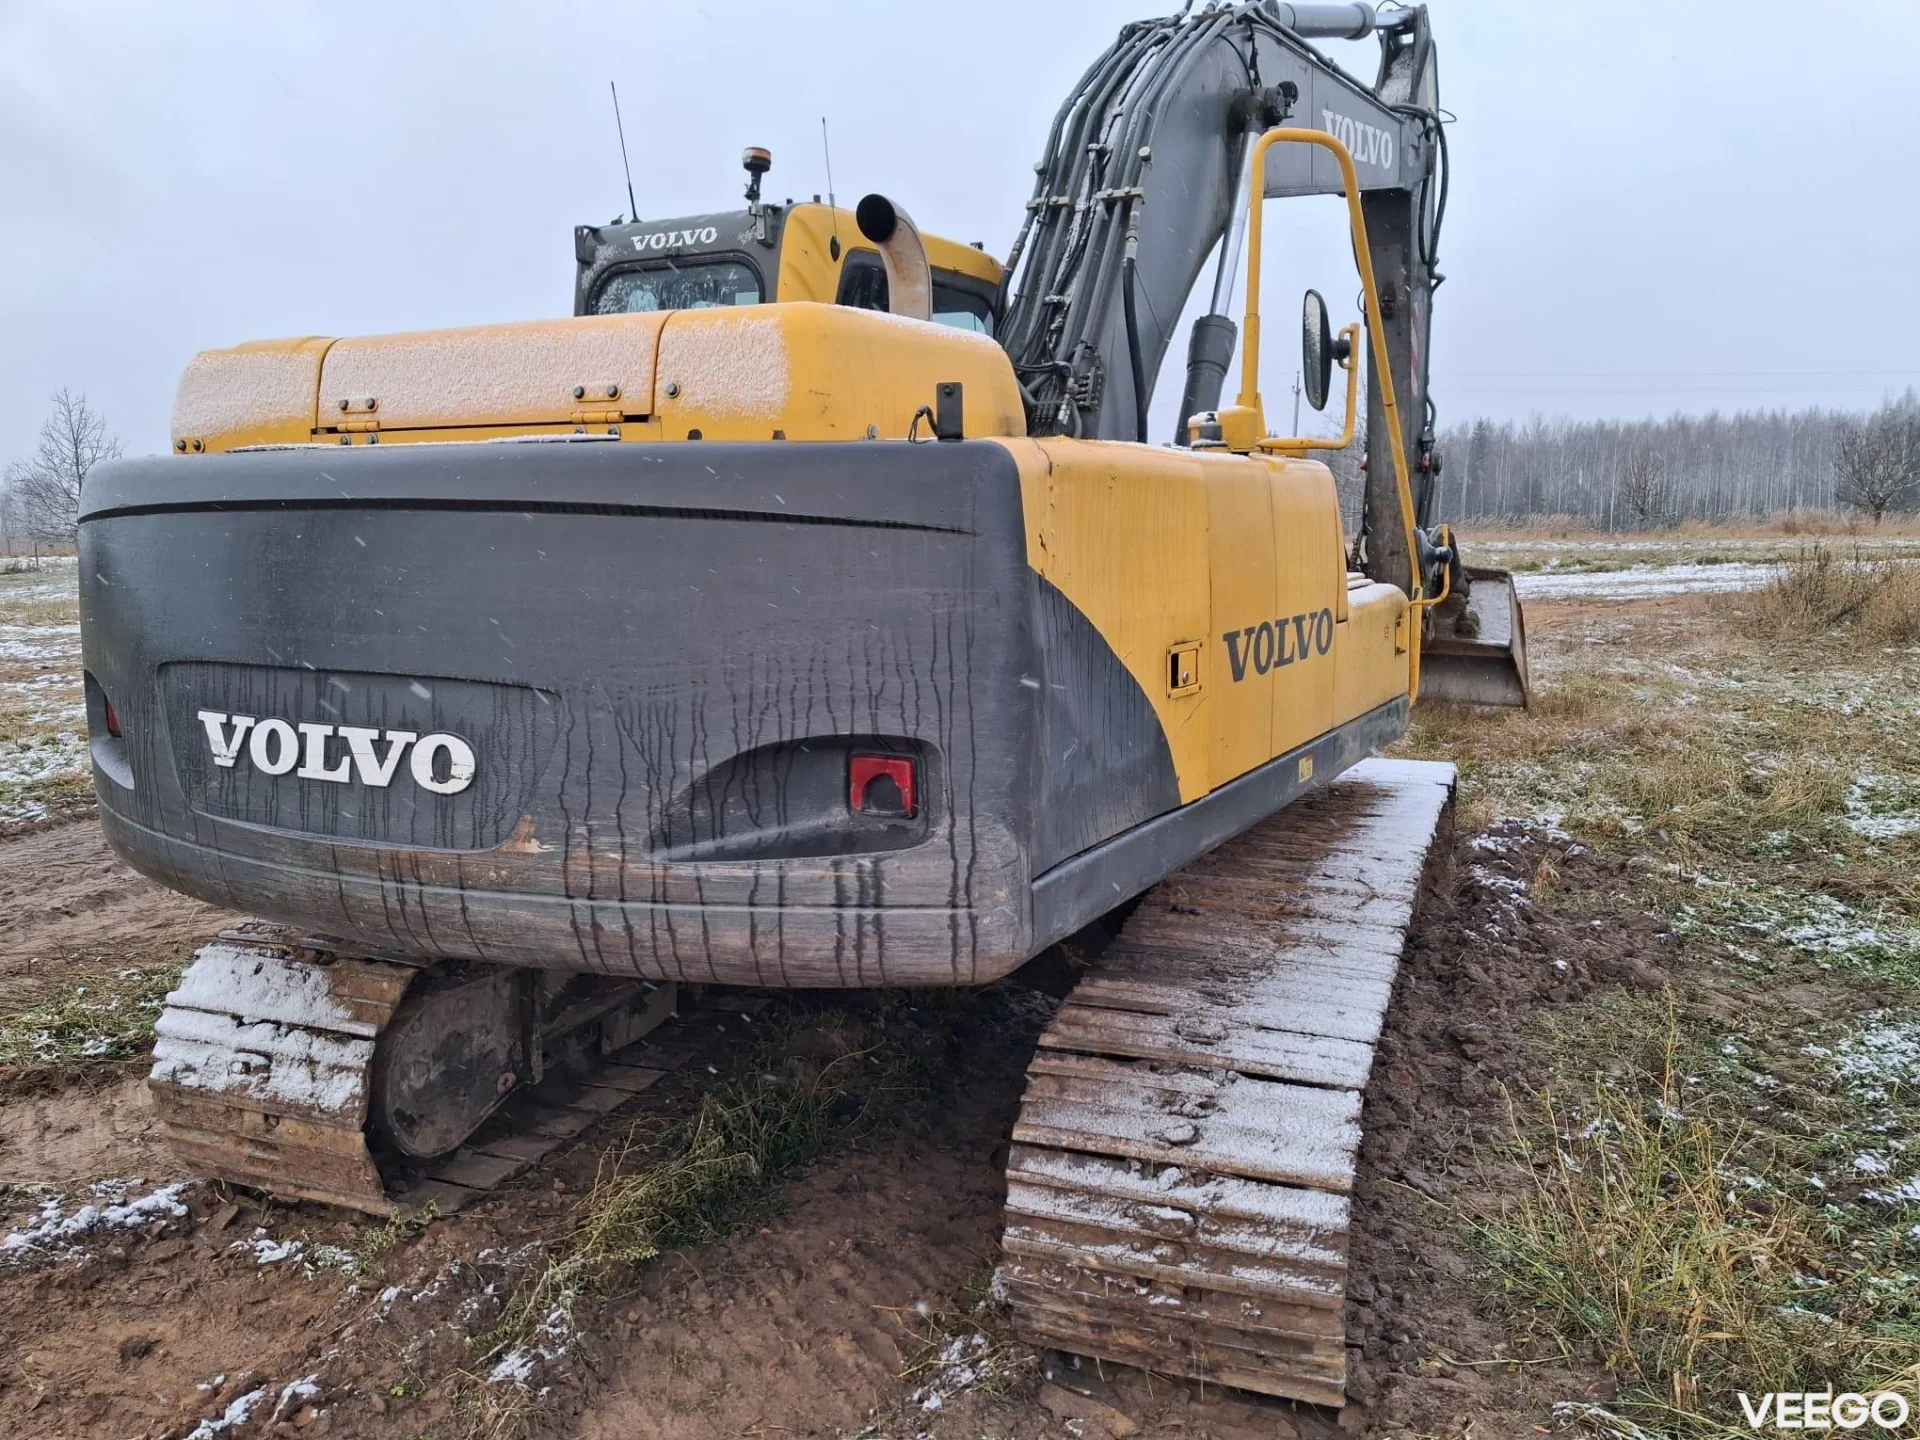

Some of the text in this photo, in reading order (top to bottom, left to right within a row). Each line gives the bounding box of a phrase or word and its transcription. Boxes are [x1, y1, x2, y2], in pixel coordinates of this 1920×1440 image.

[1322, 109, 1393, 169] VOLVO
[630, 227, 718, 251] VOLVO
[1223, 607, 1333, 683] VOLVO
[197, 710, 476, 795] VOLVO
